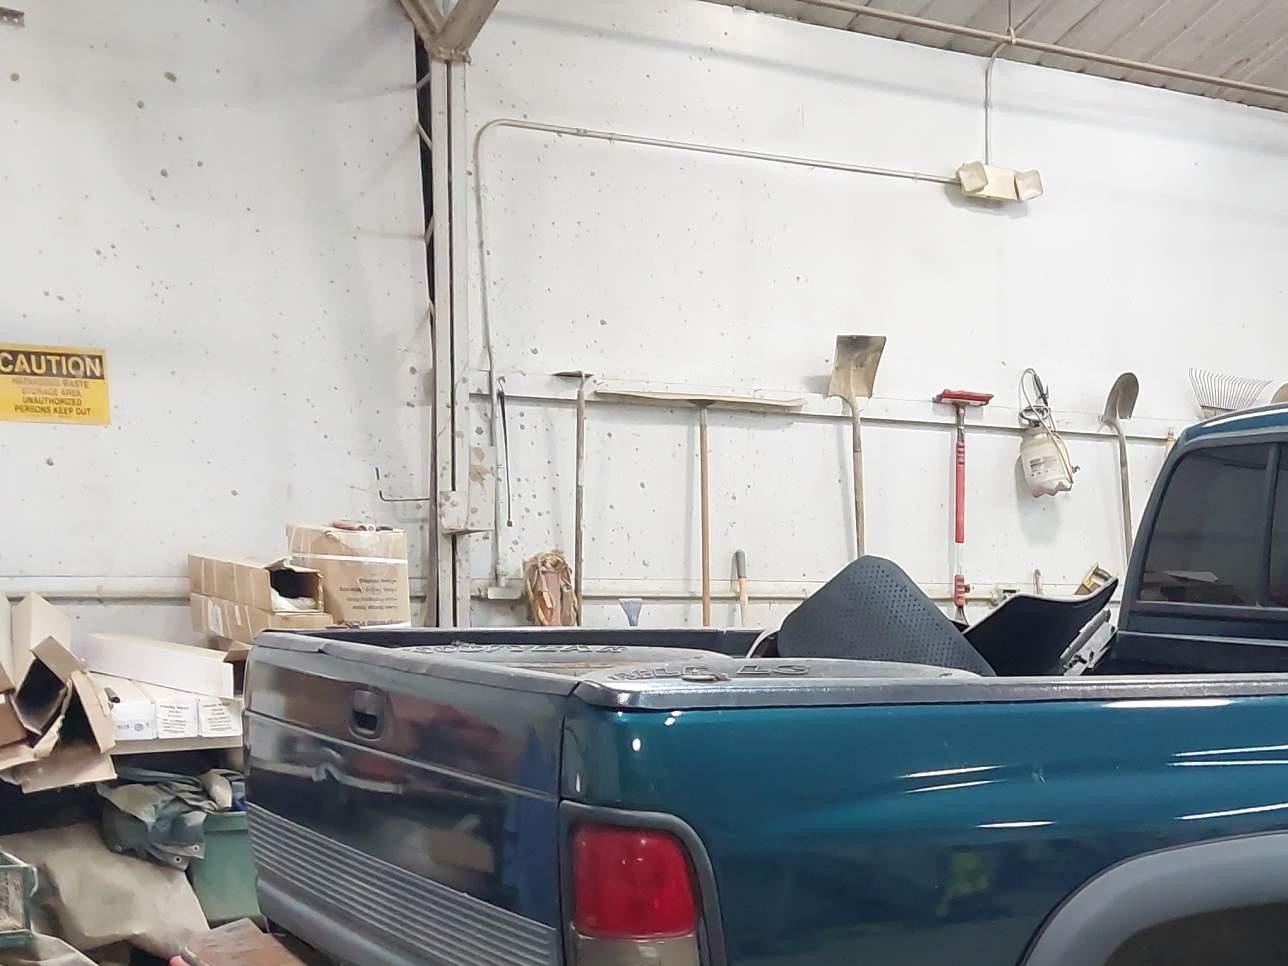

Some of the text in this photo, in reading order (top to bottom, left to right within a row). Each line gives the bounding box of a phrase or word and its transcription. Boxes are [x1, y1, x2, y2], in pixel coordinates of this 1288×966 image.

[0, 351, 101, 377] CAUTION
[14, 404, 91, 416] PERSONS KEEP OUT
